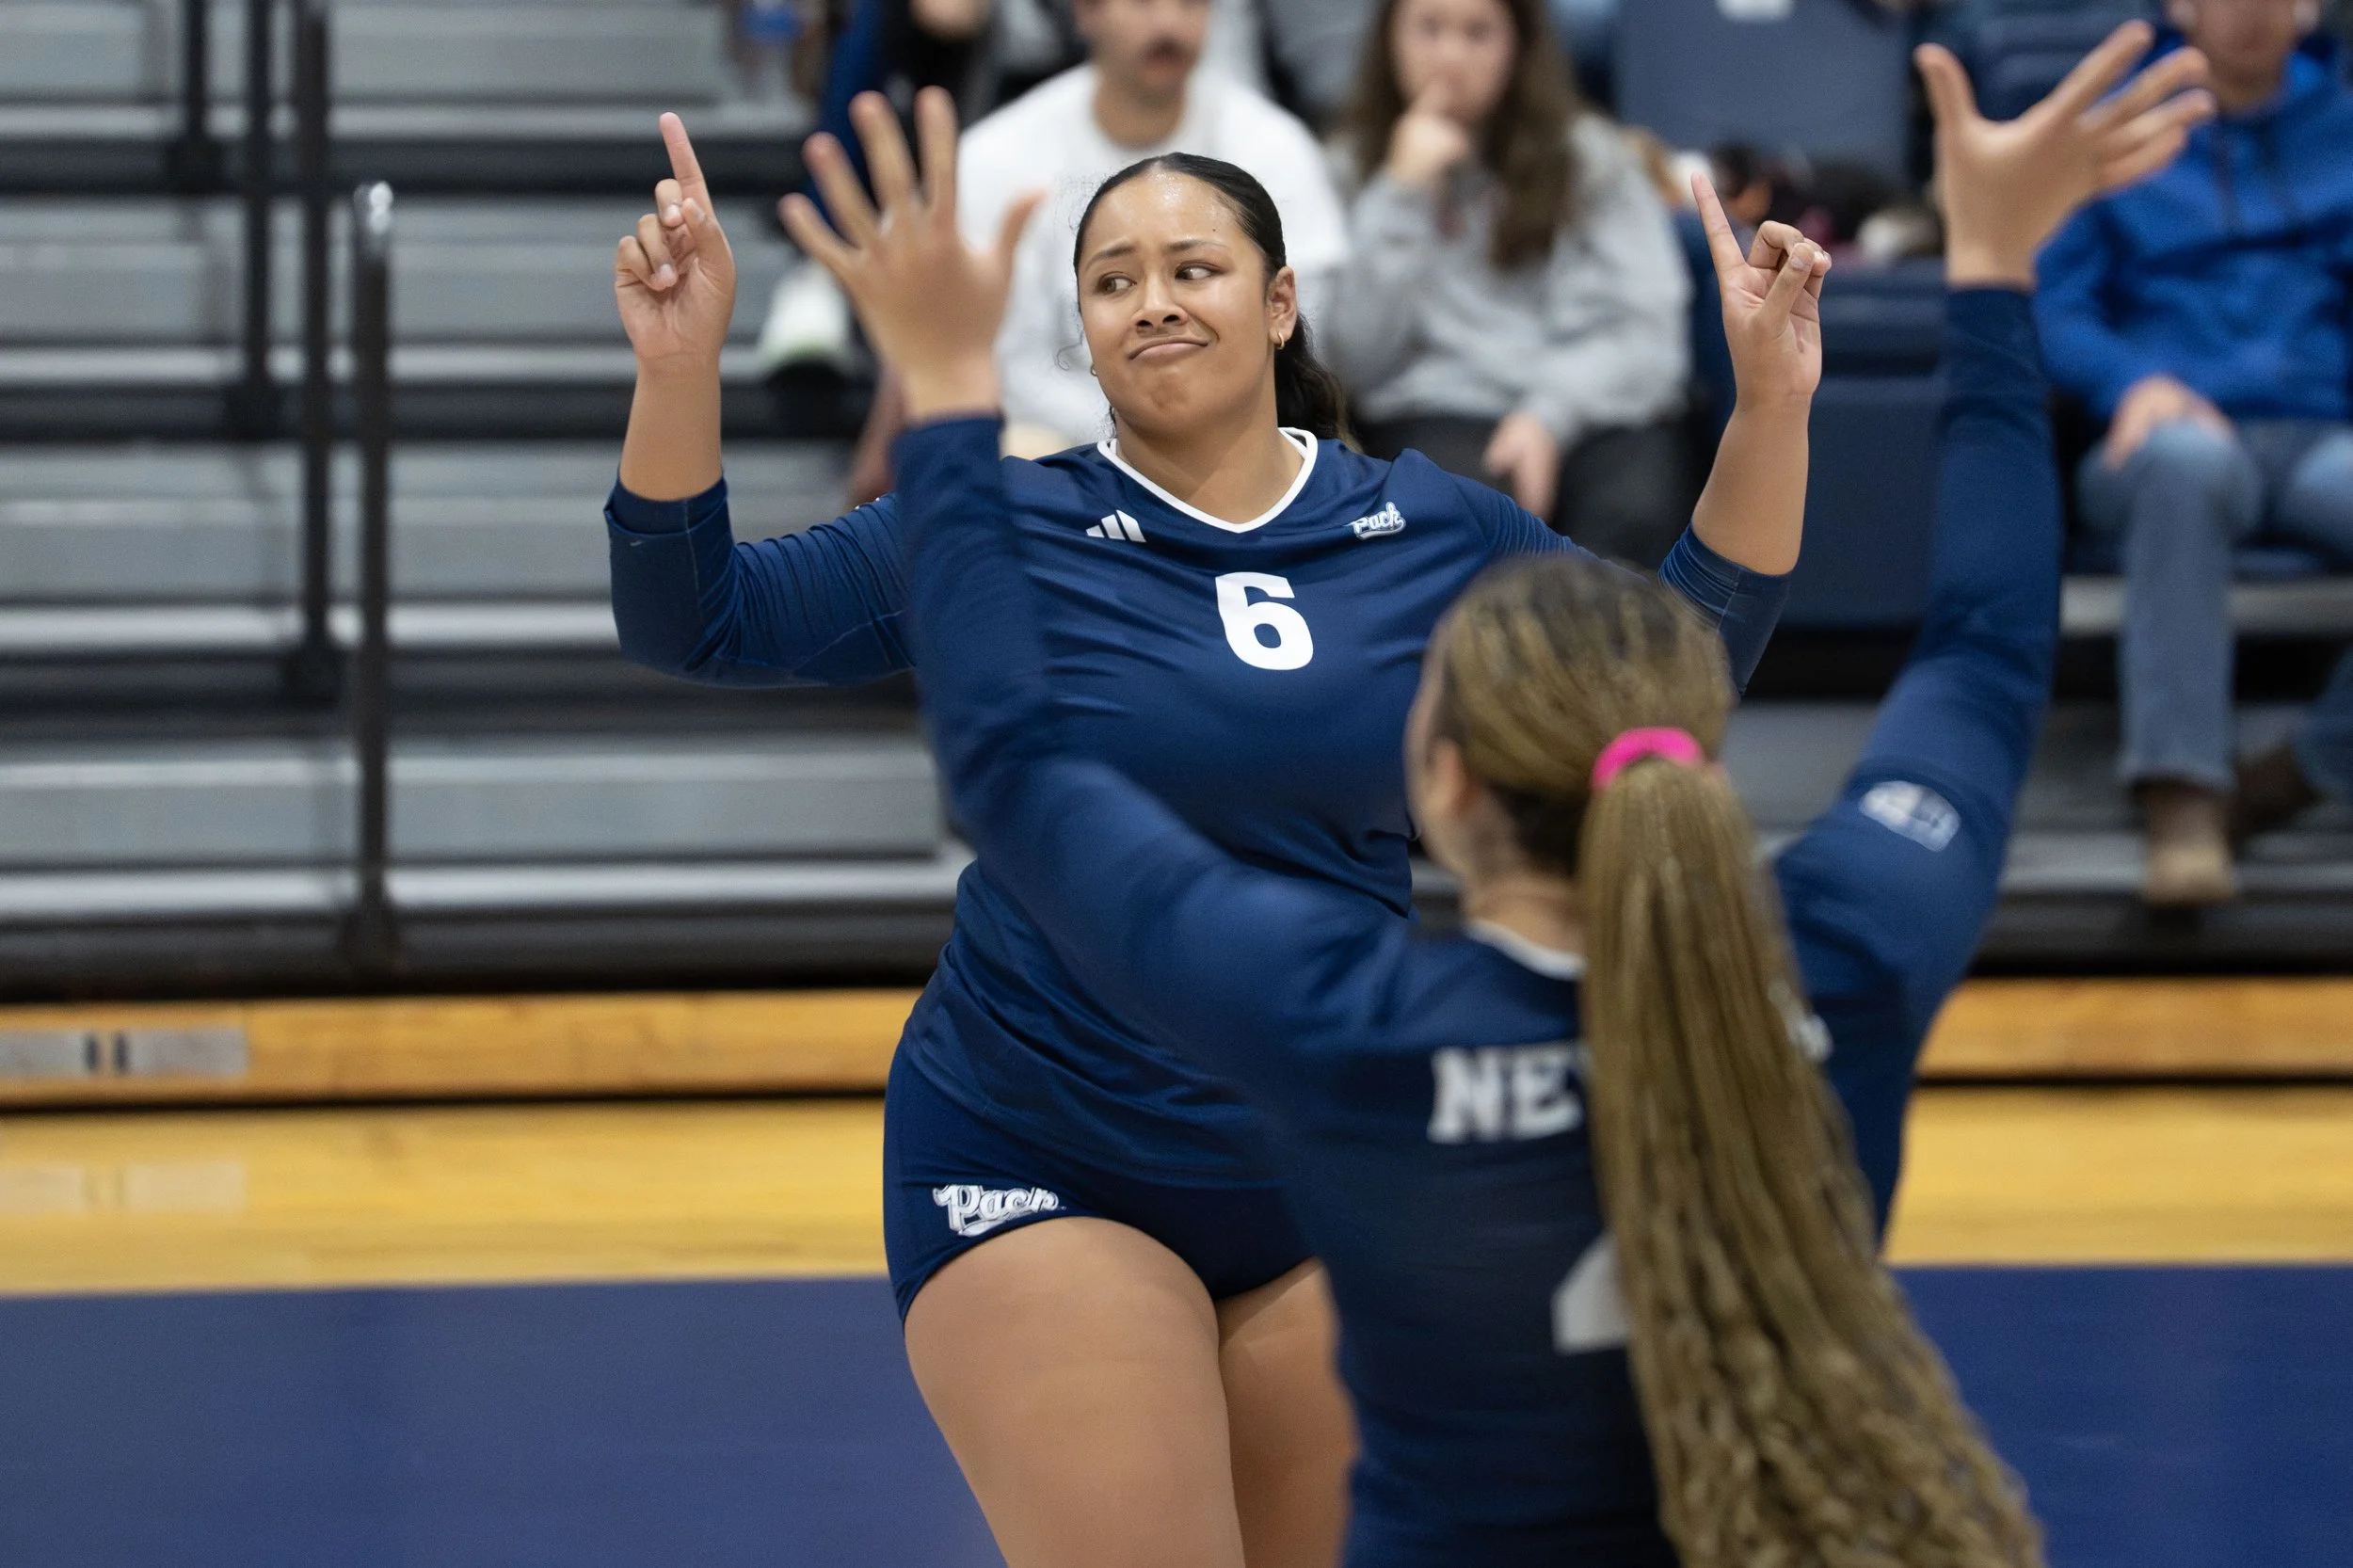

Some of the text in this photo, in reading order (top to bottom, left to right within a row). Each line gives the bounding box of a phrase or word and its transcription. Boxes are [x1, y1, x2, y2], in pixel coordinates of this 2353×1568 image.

[1342, 502, 1406, 540] Pack
[1215, 571, 1314, 671] 6
[1426, 1041, 1592, 1144] NE
